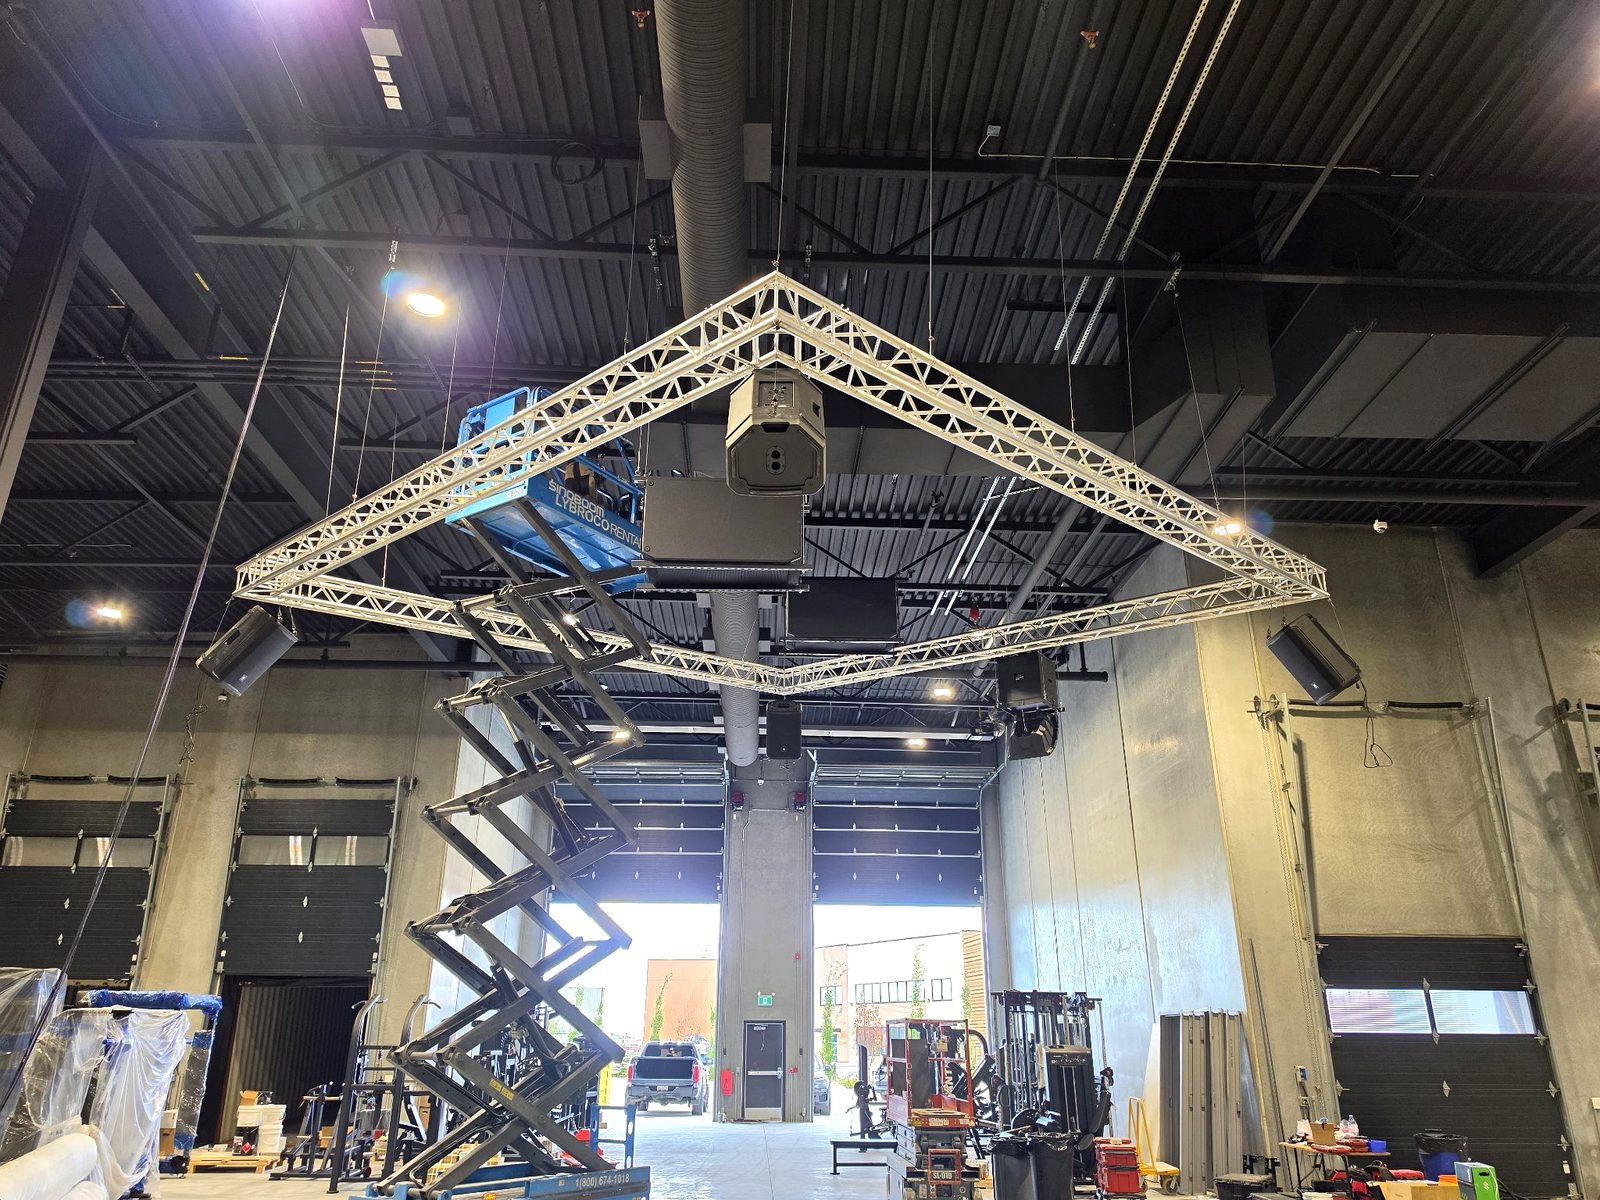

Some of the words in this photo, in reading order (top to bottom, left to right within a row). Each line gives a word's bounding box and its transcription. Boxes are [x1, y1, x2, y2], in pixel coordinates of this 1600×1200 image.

[555, 493, 610, 531] LYBROCO
[576, 1176, 597, 1190] 1(800)
[598, 1173, 630, 1186] 674-1018
